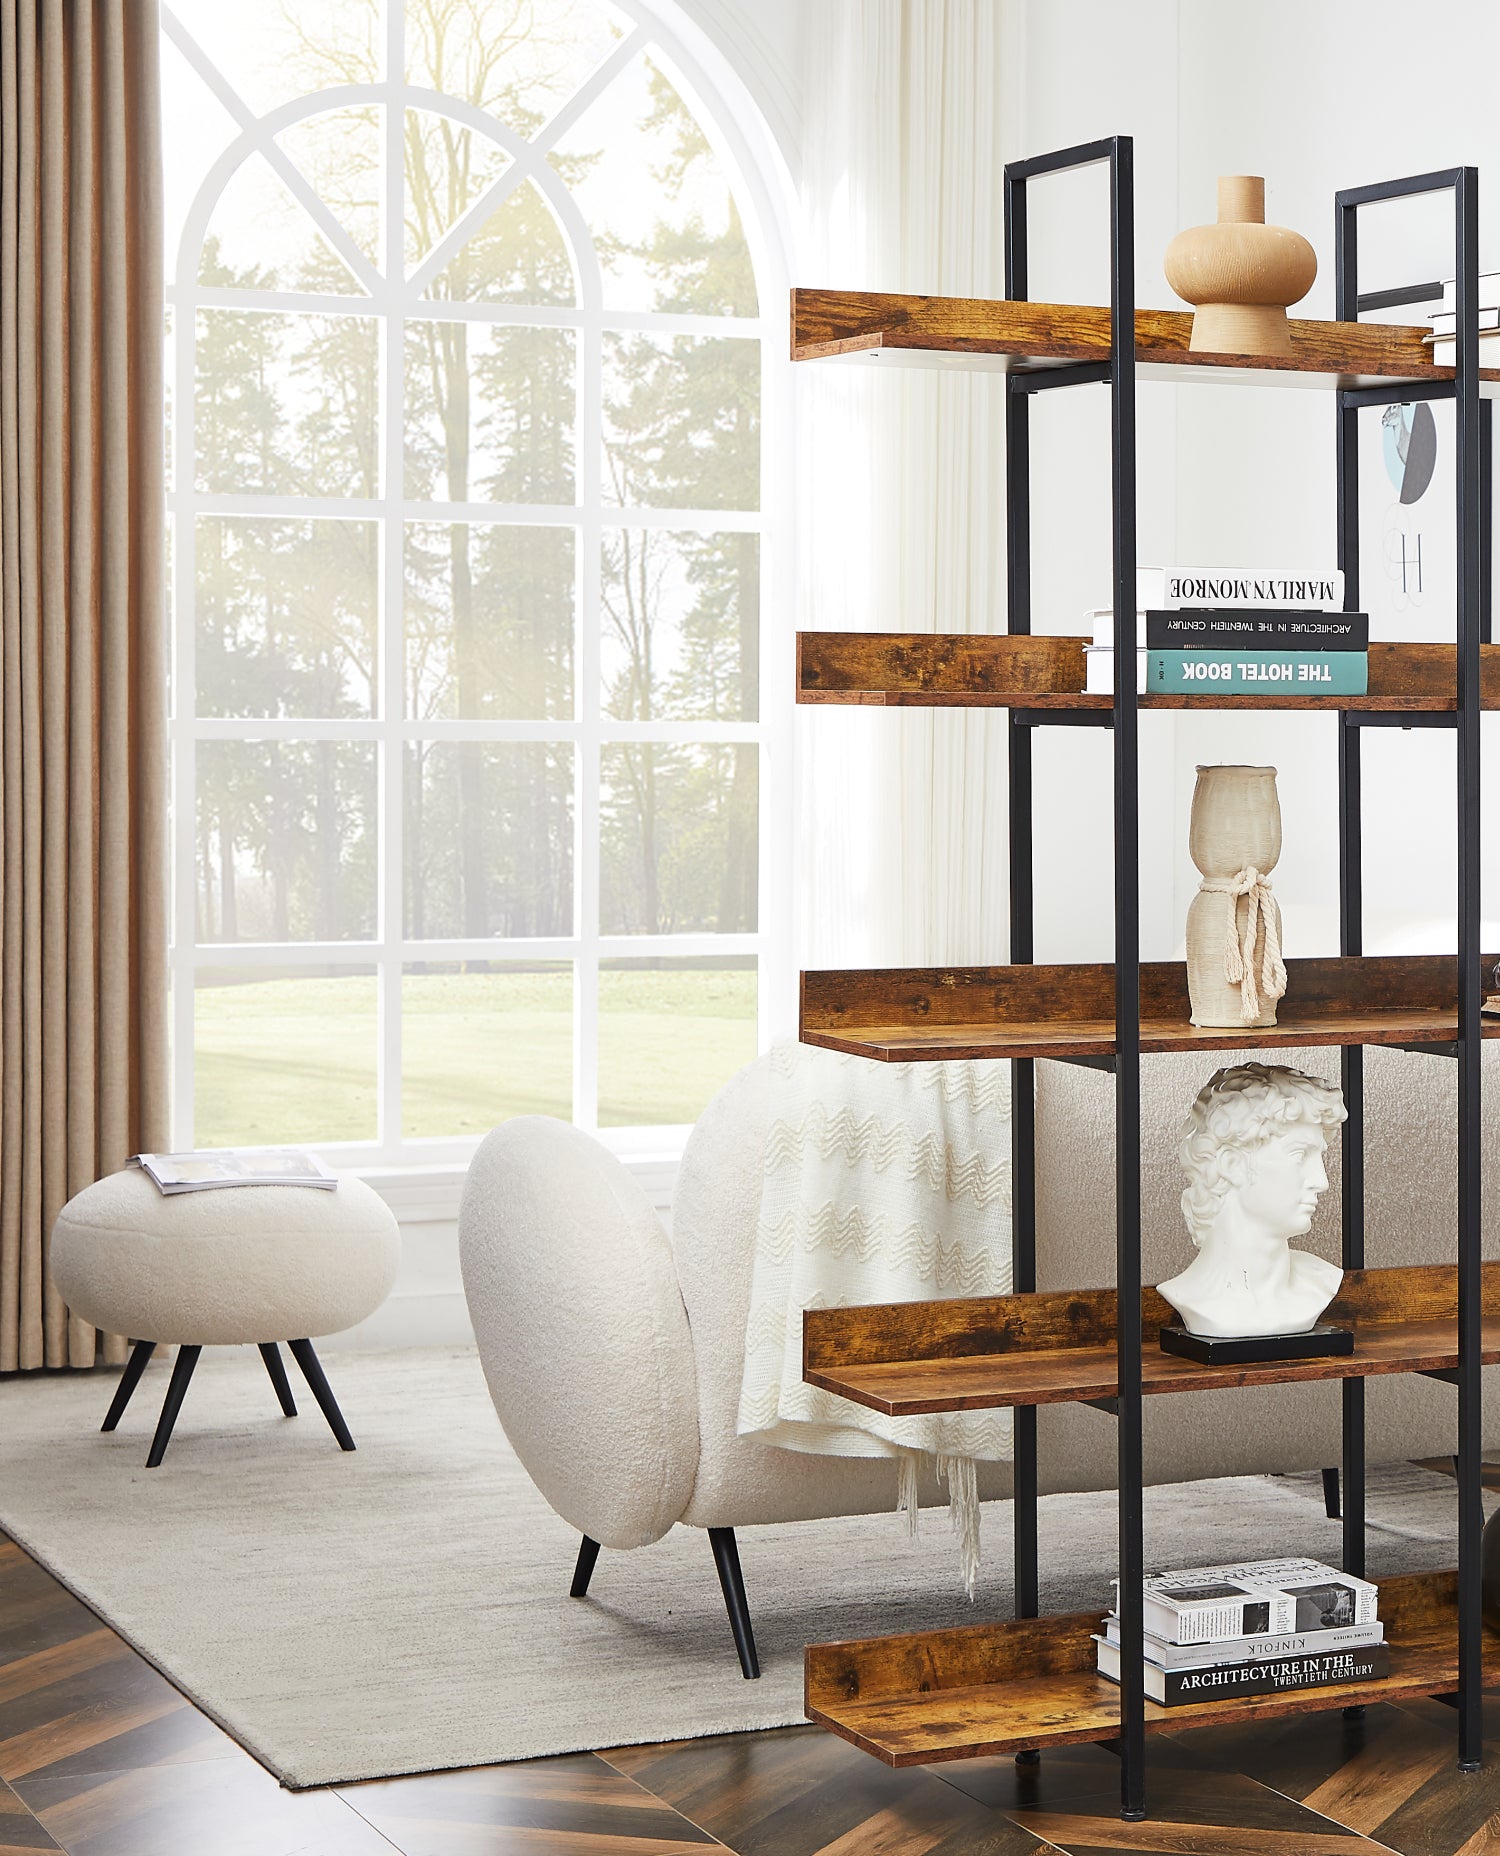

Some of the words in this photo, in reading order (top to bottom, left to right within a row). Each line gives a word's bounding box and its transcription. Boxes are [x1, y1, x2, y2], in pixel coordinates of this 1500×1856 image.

[1170, 578, 1248, 598] MONROE
[1253, 580, 1335, 600] MARILYN
[1167, 620, 1206, 630] CENTURY
[1210, 621, 1254, 631] TWENTIETH
[1258, 622, 1273, 632] THE
[1278, 623, 1287, 632] IN
[1290, 623, 1352, 634] ARCHITECTURE
[1182, 662, 1232, 680] BOOK
[1237, 663, 1293, 681] HOTEL
[1298, 664, 1332, 681] THE
[1248, 1638, 1306, 1655] KINFOLK
[1180, 1664, 1299, 1690] ARCHITECYURE
[1302, 1659, 1320, 1673] IN
[1323, 1654, 1354, 1669] THE
[1274, 1673, 1328, 1687] TWENTIETH
[1331, 1664, 1373, 1679] CENTURY
